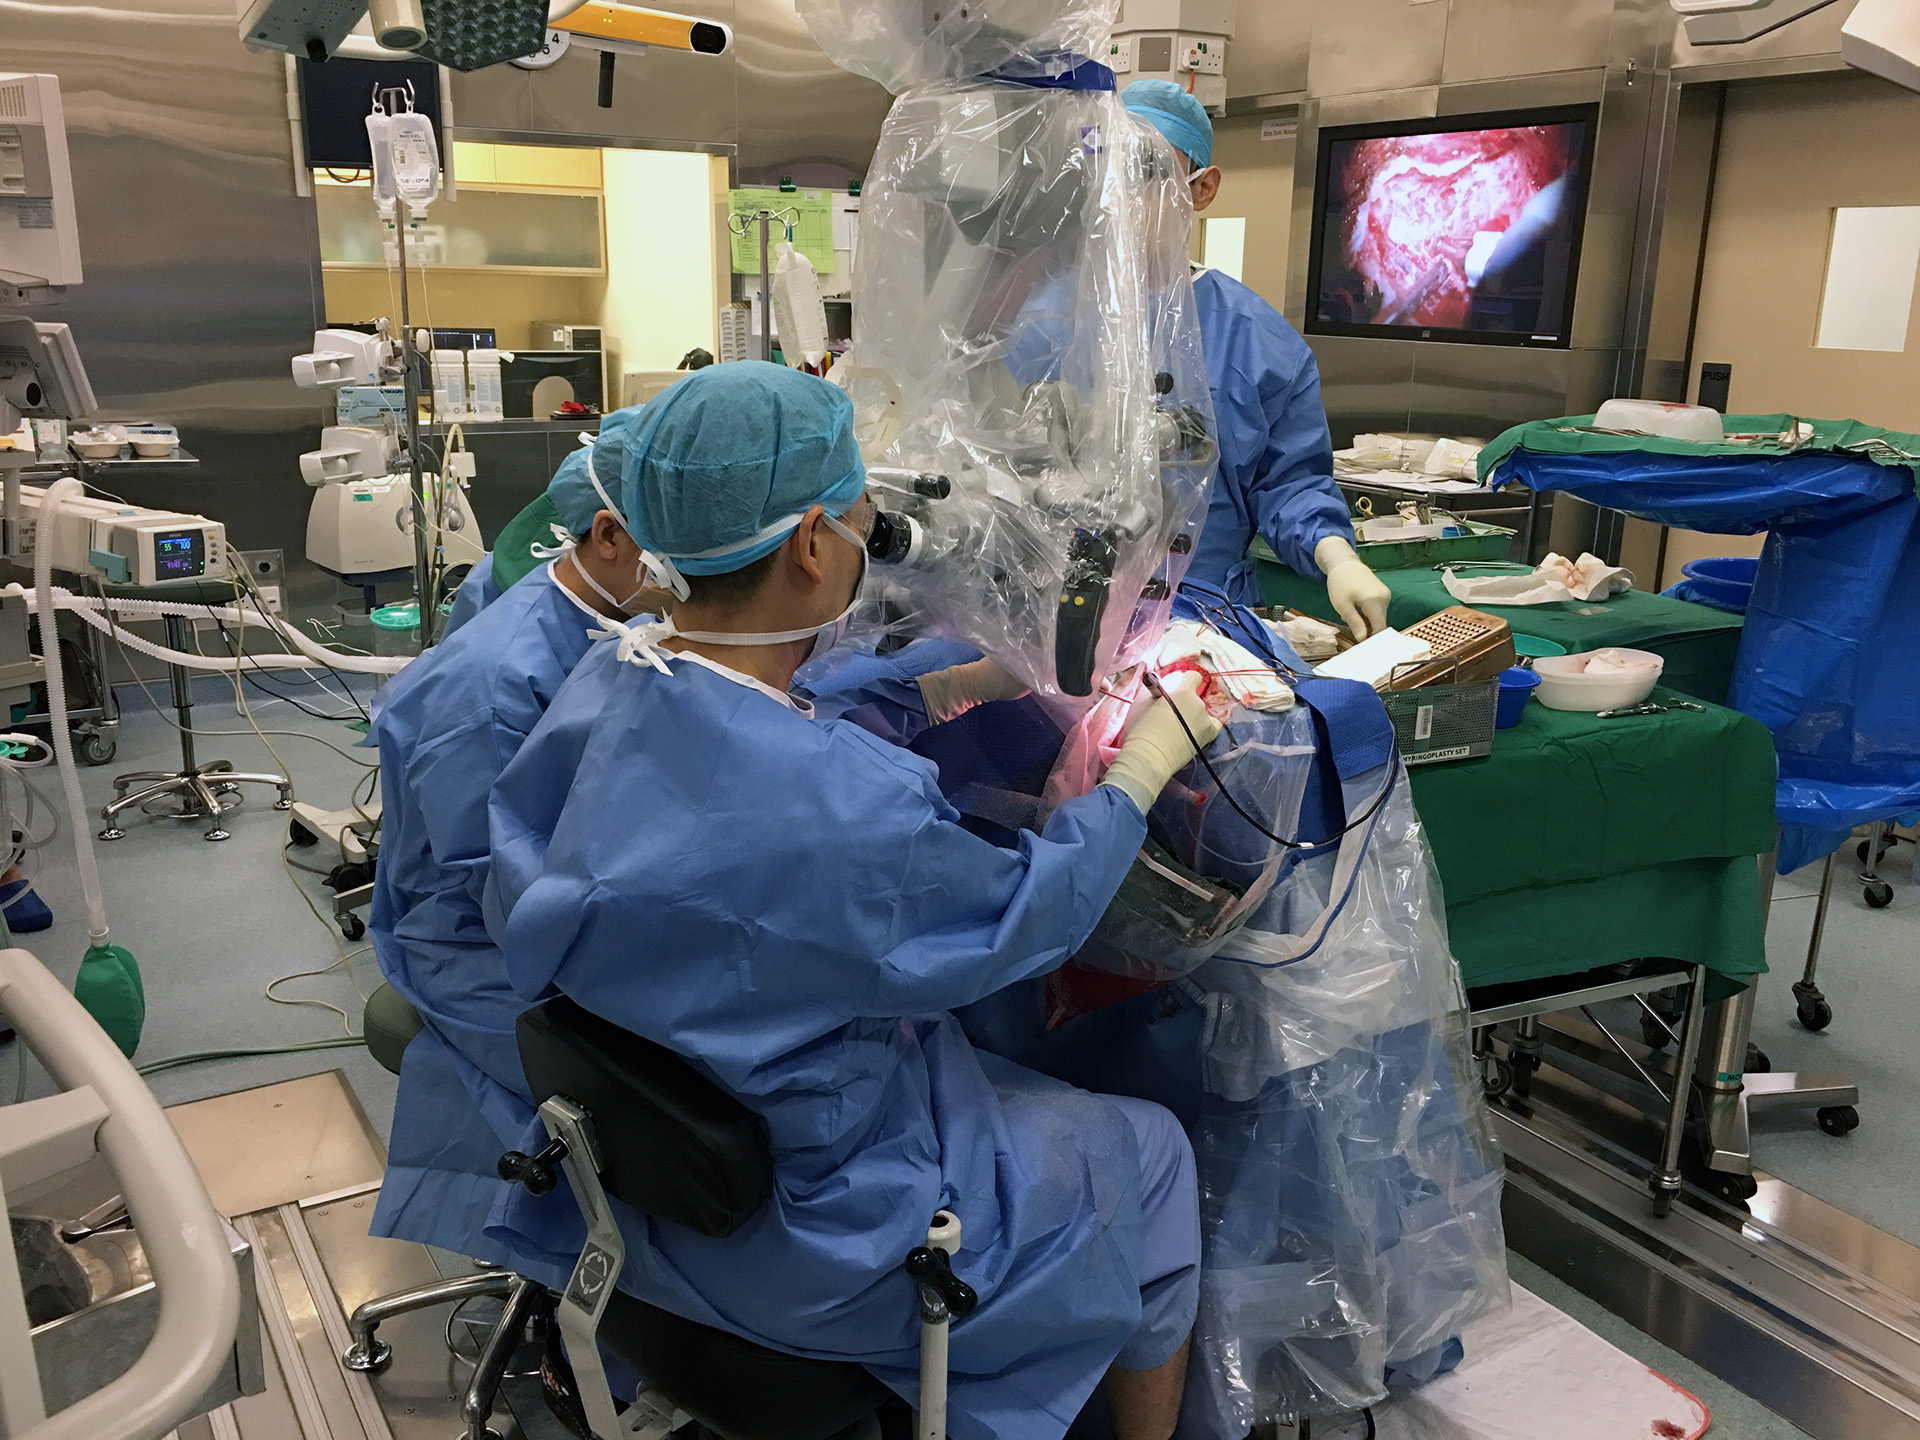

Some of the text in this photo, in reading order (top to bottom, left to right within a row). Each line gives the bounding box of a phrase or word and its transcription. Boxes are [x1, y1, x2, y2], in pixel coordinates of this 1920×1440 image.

[552, 33, 560, 44] 4
[543, 44, 550, 55] 5
[1702, 371, 1730, 381] PUSH
[164, 540, 191, 551] 55 100
[1402, 747, 1467, 763] MYRINGOPLASTY SET
